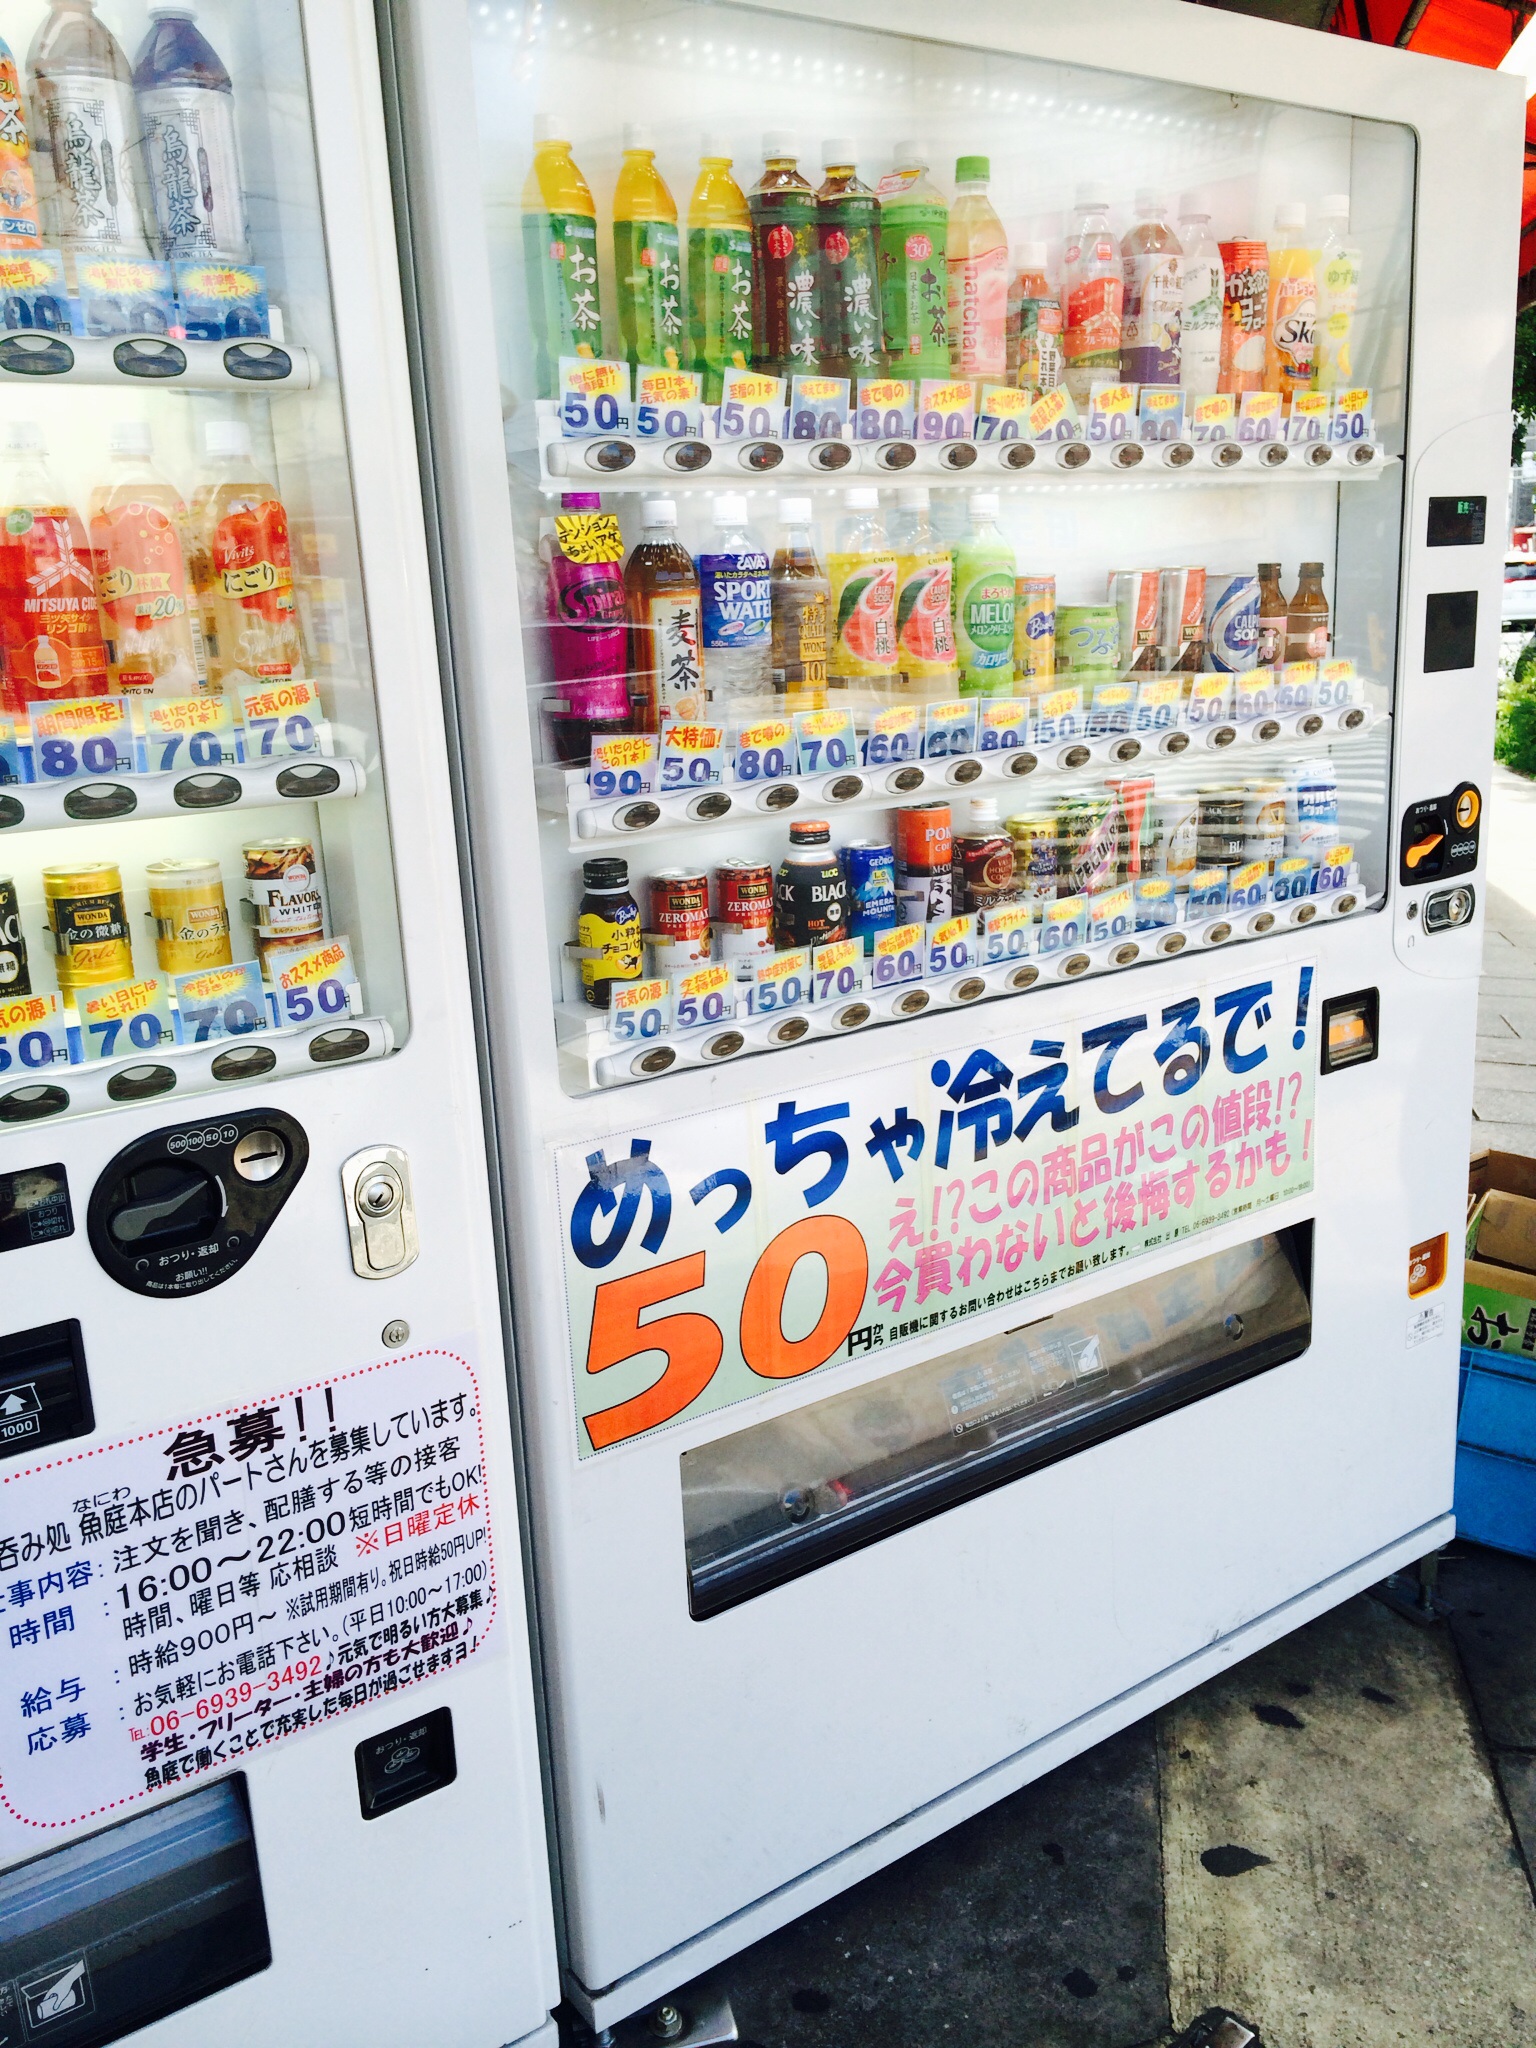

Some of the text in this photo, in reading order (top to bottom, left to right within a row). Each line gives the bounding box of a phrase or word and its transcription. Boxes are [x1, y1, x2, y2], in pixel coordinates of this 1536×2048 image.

[64, 111, 104, 229] 烏龍茶
[161, 123, 201, 238] 烏龍茶
[569, 245, 601, 332] お茶
[659, 252, 683, 336] お茶
[728, 258, 752, 340] お茶
[787, 268, 820, 367] 濃い味
[844, 272, 880, 368] 濃い味
[224, 561, 276, 593] にごり
[24, 597, 80, 613] MITSUYA
[665, 608, 700, 692] 麦茶
[875, 616, 891, 656] 白桃
[932, 615, 949, 654] 白桃
[37, 699, 125, 737] 期間限定！
[671, 895, 702, 907] WONDA
[740, 883, 768, 895] WONDA
[77, 912, 108, 922] WONDA
[189, 907, 220, 919] WONDA
[279, 944, 346, 989] おススメ商品
[169, 1130, 235, 1149] 500 100 50 10
[571, 966, 1314, 1269] めっちゃ冷えてるで！
[159, 1243, 220, 1267] おつり・返却
[1, 1420, 33, 1438] 1000
[79, 1392, 477, 1546] 魚庭本店のパートさんを募集しています。
[73, 1486, 131, 1513] なにわ
[114, 1436, 461, 1574] 注文を聞き、配膳する等の接客
[270, 1544, 339, 1590] 応相談
[9, 1605, 76, 1649] 時間
[20, 1676, 86, 1719] 給与
[27, 1711, 92, 1756] 応募
